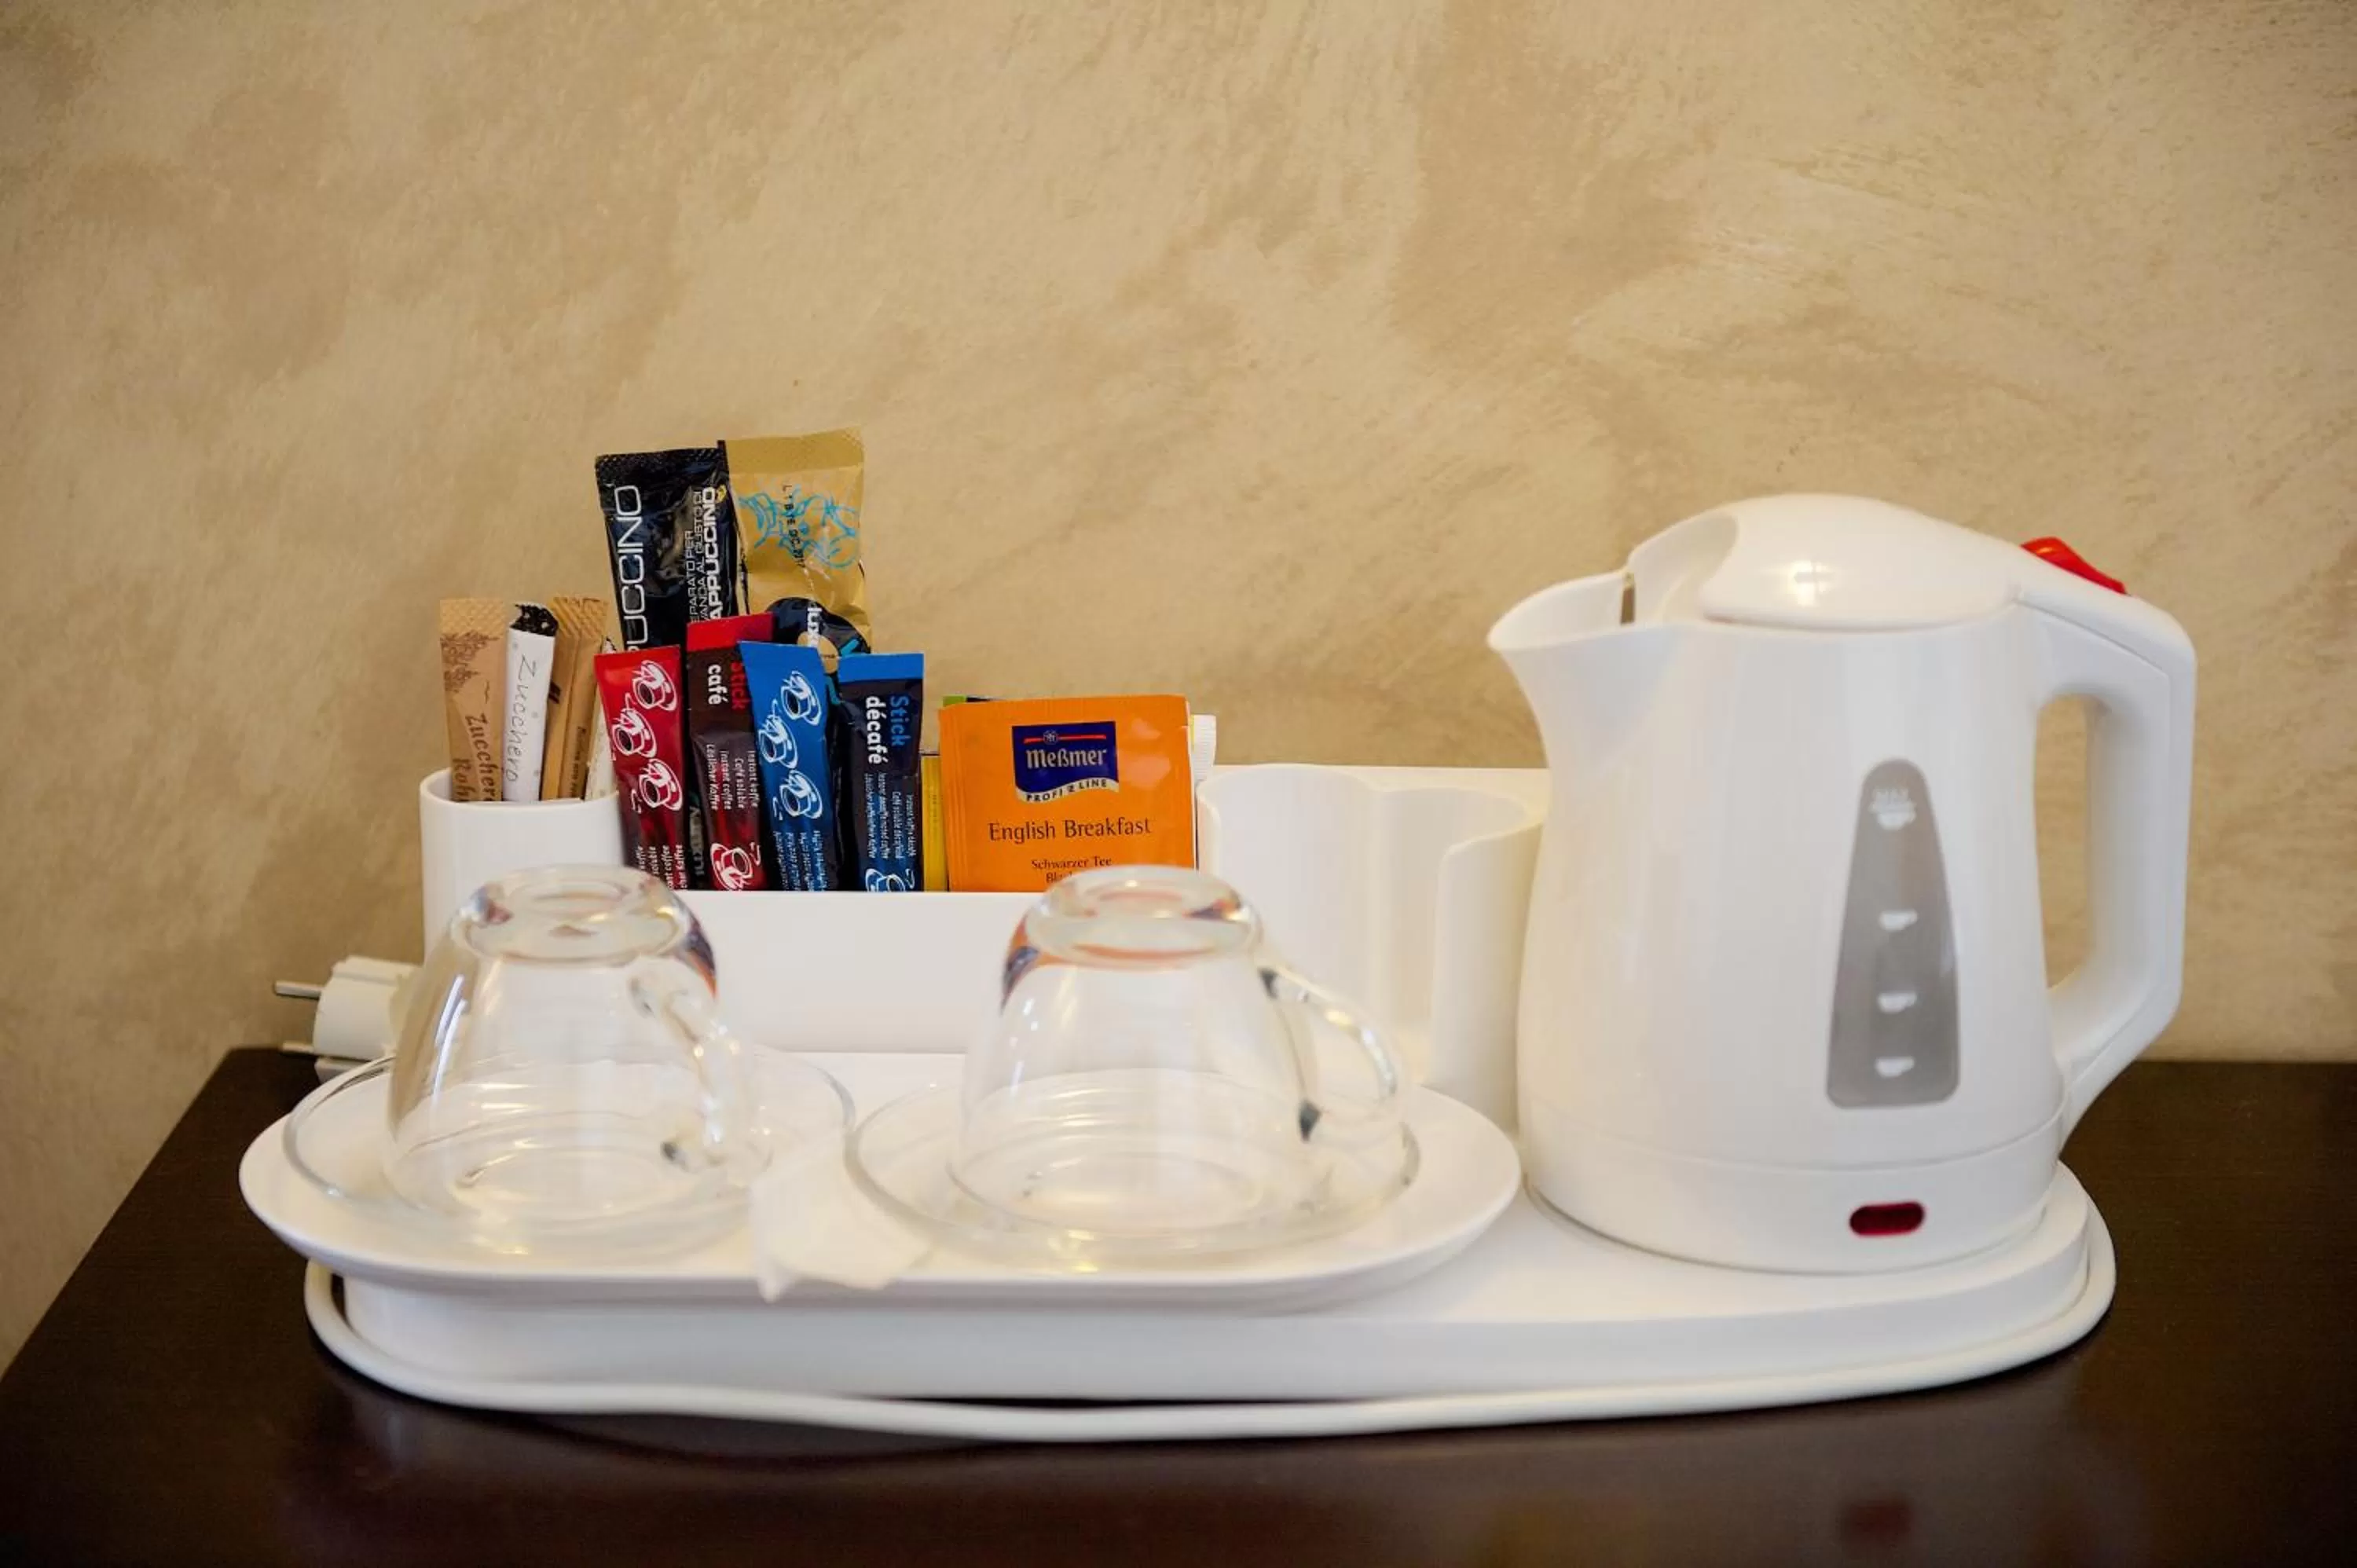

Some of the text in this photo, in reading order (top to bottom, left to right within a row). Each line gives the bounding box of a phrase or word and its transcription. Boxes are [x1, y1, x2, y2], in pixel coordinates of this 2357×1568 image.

[694, 505, 705, 553] GUSTO
[684, 530, 695, 559] PER
[702, 485, 723, 620] APPUCCINO
[614, 485, 648, 651] UCCINO
[697, 557, 706, 572] AL
[708, 664, 728, 705] café
[506, 654, 537, 782] Zucchero
[865, 696, 888, 764] décafé
[889, 695, 911, 746] Stick
[1026, 747, 1107, 770] Meßmer
[709, 783, 720, 810] Kaffee
[722, 783, 732, 810] coffee
[1026, 779, 1107, 802] PROFI LINE
[988, 817, 1150, 844] English Breakfast
[673, 844, 685, 870] Kaffee
[1031, 855, 1113, 870] Schwarzer Tee
